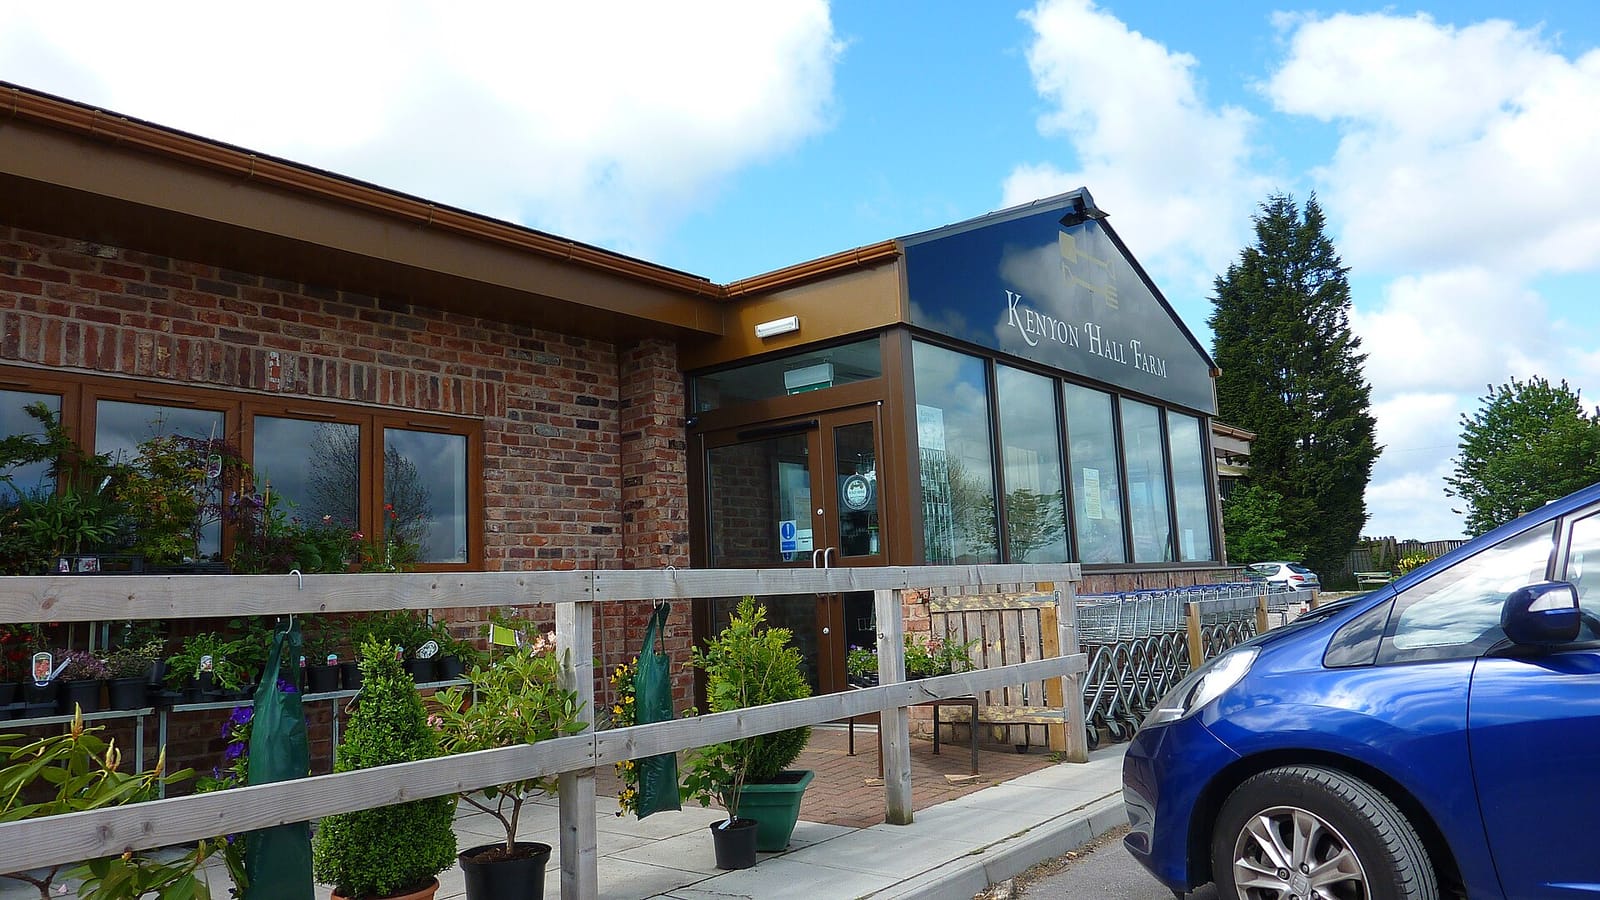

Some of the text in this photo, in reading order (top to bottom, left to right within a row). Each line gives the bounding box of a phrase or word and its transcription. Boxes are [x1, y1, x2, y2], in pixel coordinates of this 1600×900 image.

[1005, 289, 1167, 378] KENYON HALL FARM
